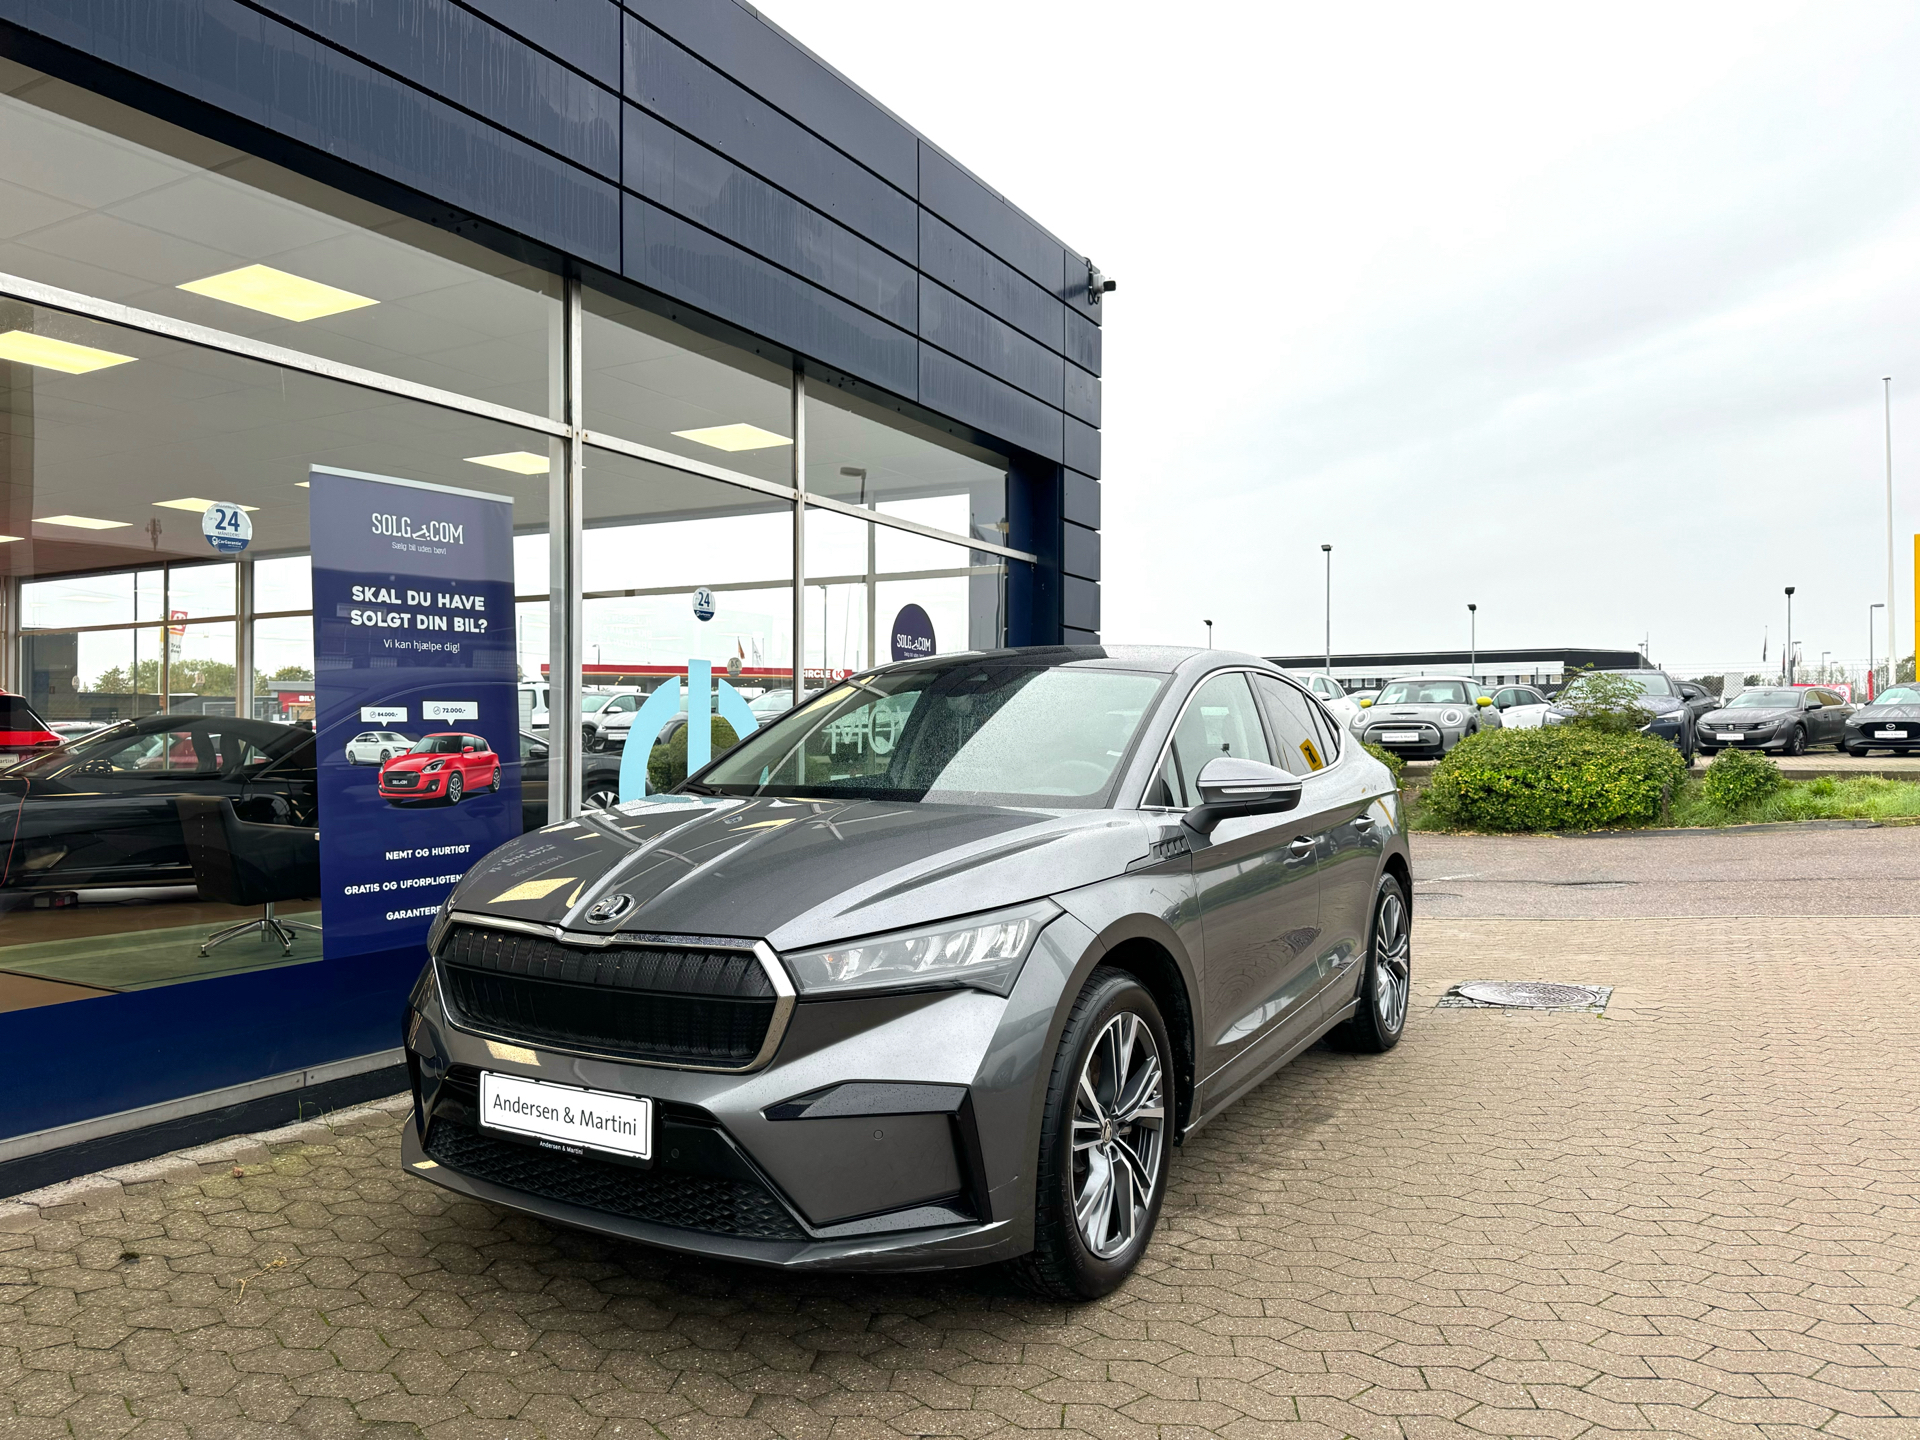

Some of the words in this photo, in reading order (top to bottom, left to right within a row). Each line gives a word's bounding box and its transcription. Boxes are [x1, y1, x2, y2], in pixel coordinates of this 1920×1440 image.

[215, 508, 240, 532] 24
[391, 541, 407, 552] Sælg
[417, 545, 432, 554] uden
[351, 585, 402, 605] SKAL
[407, 590, 431, 607] DU
[437, 593, 485, 611] HAVE
[698, 591, 710, 608] 24
[350, 609, 411, 629] SOLGT
[416, 614, 447, 631] DIN
[453, 617, 488, 633] BIL?
[383, 639, 393, 648] Vi
[395, 640, 412, 649] kan
[413, 640, 442, 652] hjælpe
[444, 642, 460, 653] dig!
[803, 669, 831, 678] IRCLE
[836, 670, 843, 678] K
[385, 849, 413, 860] NEMT
[415, 848, 430, 858] OG
[431, 844, 471, 856] HURTIGT
[344, 883, 380, 895] GRATIS
[382, 881, 398, 891] OG
[400, 873, 465, 889] UFORPLIGTEN
[493, 1093, 559, 1122] Andersen
[563, 1106, 575, 1125] &
[579, 1109, 637, 1136] Martini
[539, 1140, 562, 1151] Andersen
[566, 1146, 584, 1155] Martini
